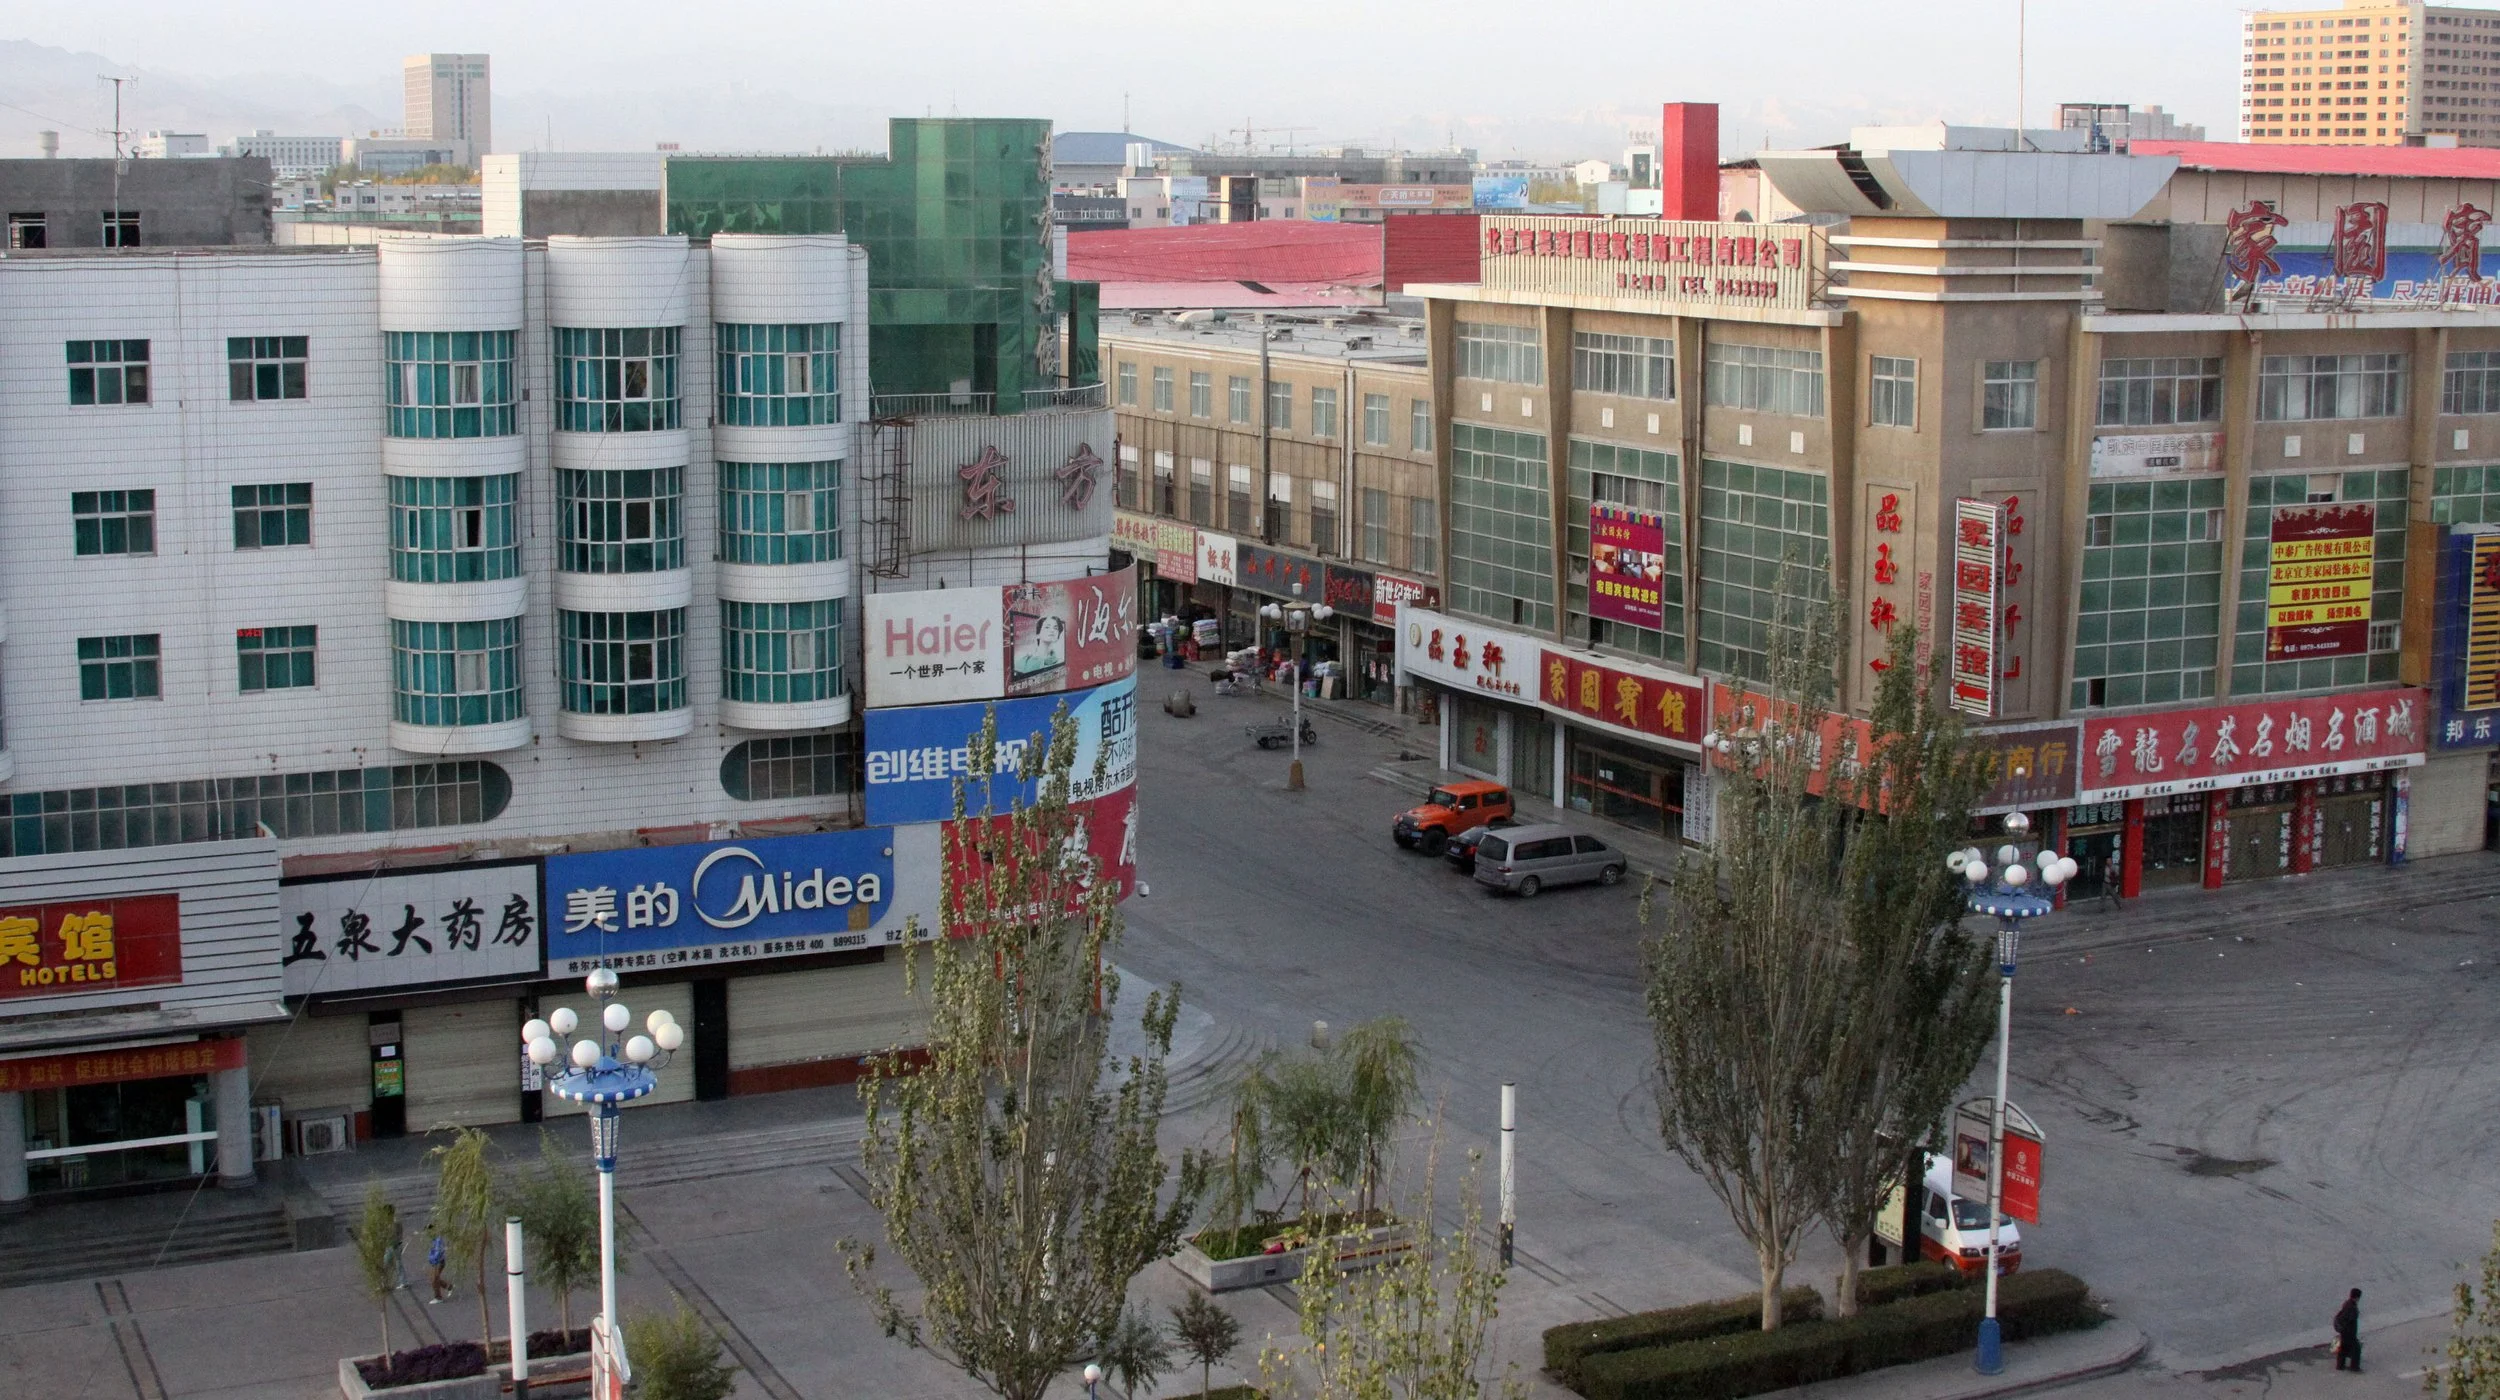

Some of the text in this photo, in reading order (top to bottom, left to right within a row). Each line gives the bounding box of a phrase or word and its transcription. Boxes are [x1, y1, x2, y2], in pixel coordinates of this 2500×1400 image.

[1679, 276, 1708, 294] TEL
[885, 614, 992, 657] Haier
[889, 660, 986, 681] 一个世界一个家
[563, 866, 882, 934] 美的 Midea
[282, 893, 536, 967] 五泉大药房
[568, 954, 657, 973] 格尔木品牌专卖店
[691, 948, 713, 961] 冰箱
[763, 940, 806, 954] 服务热线
[809, 939, 824, 950] 400
[20, 961, 118, 987] HOTELS
